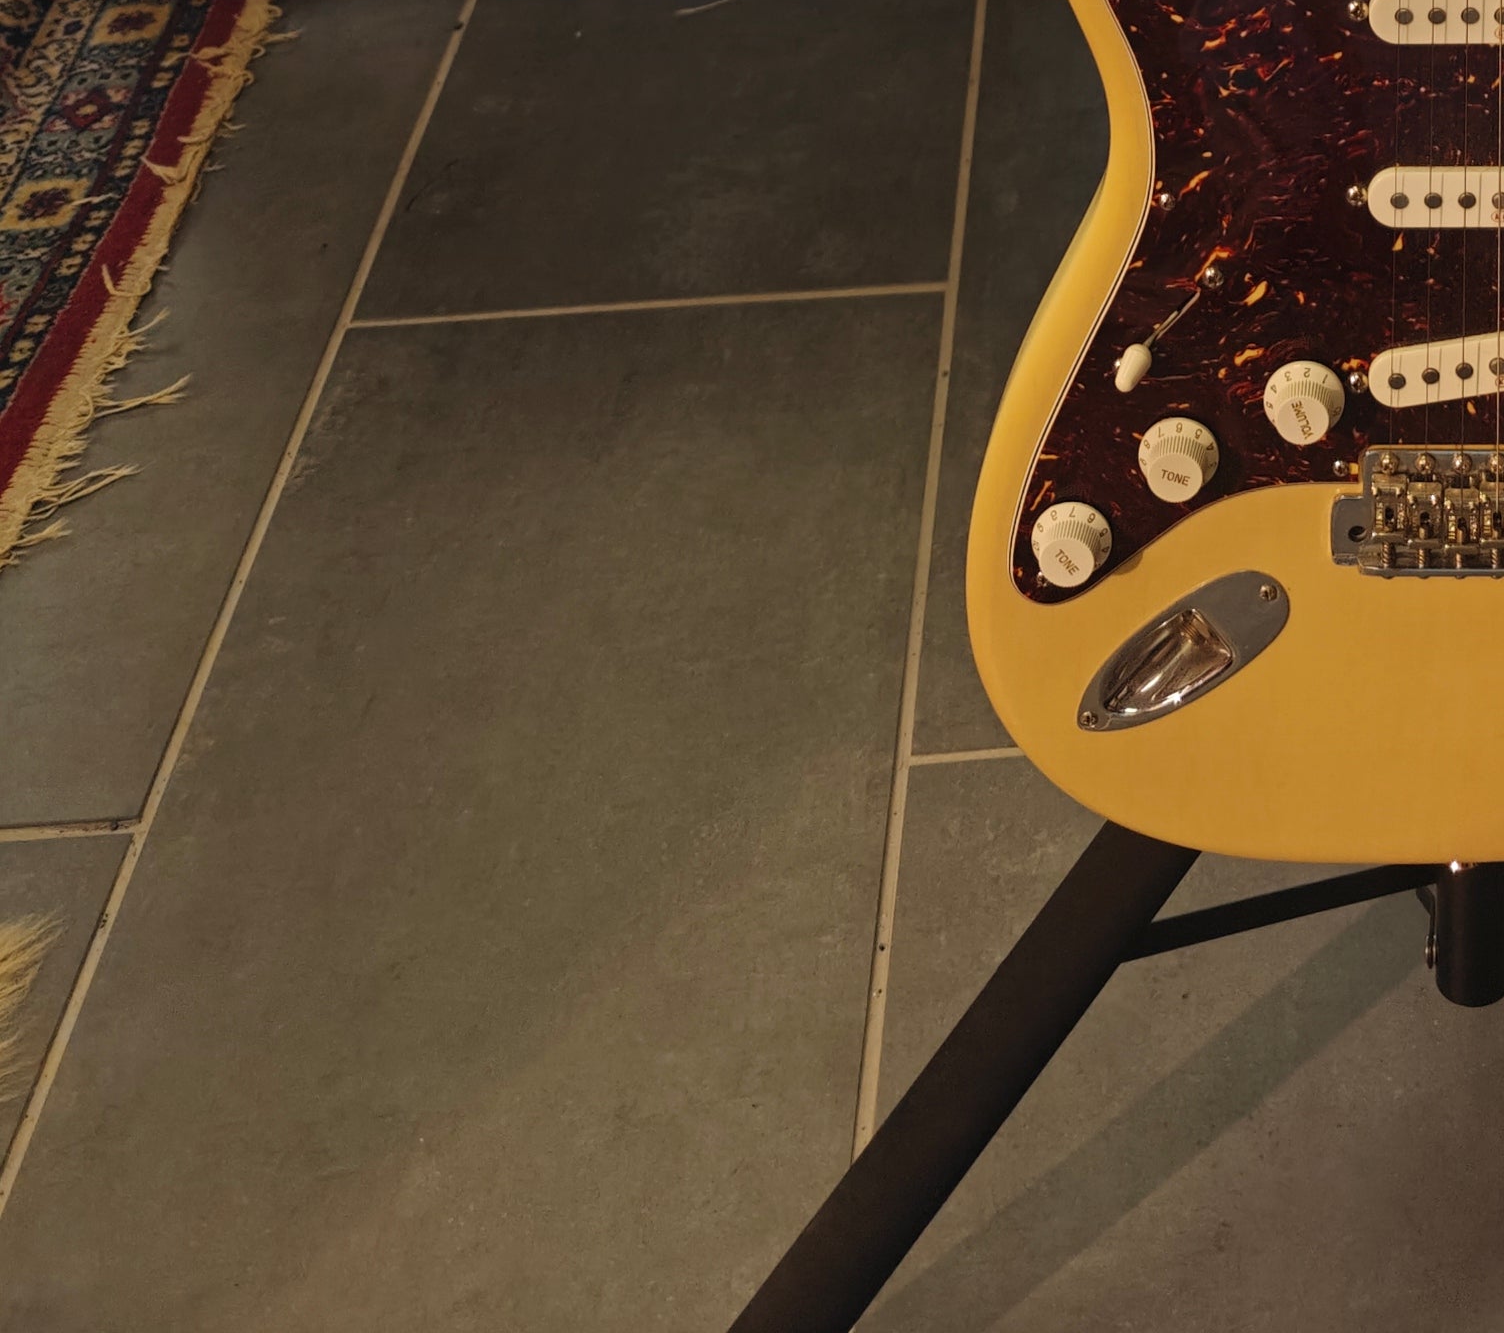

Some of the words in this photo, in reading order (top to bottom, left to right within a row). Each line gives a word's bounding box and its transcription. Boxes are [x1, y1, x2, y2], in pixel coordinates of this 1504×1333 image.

[1284, 371, 1292, 382] 3
[1303, 367, 1311, 378] 2
[1322, 374, 1328, 384] 1
[1270, 384, 1277, 393] 4
[1291, 400, 1314, 440] VOLUME
[1158, 426, 1164, 438] 7
[1175, 422, 1183, 433] 6
[1195, 428, 1203, 439] 5
[1143, 439, 1151, 449] 8
[1206, 442, 1214, 450] 4
[1161, 469, 1191, 486] TONE
[1069, 506, 1075, 517] 7
[1087, 512, 1096, 523] 6
[1055, 548, 1080, 576] TONE
